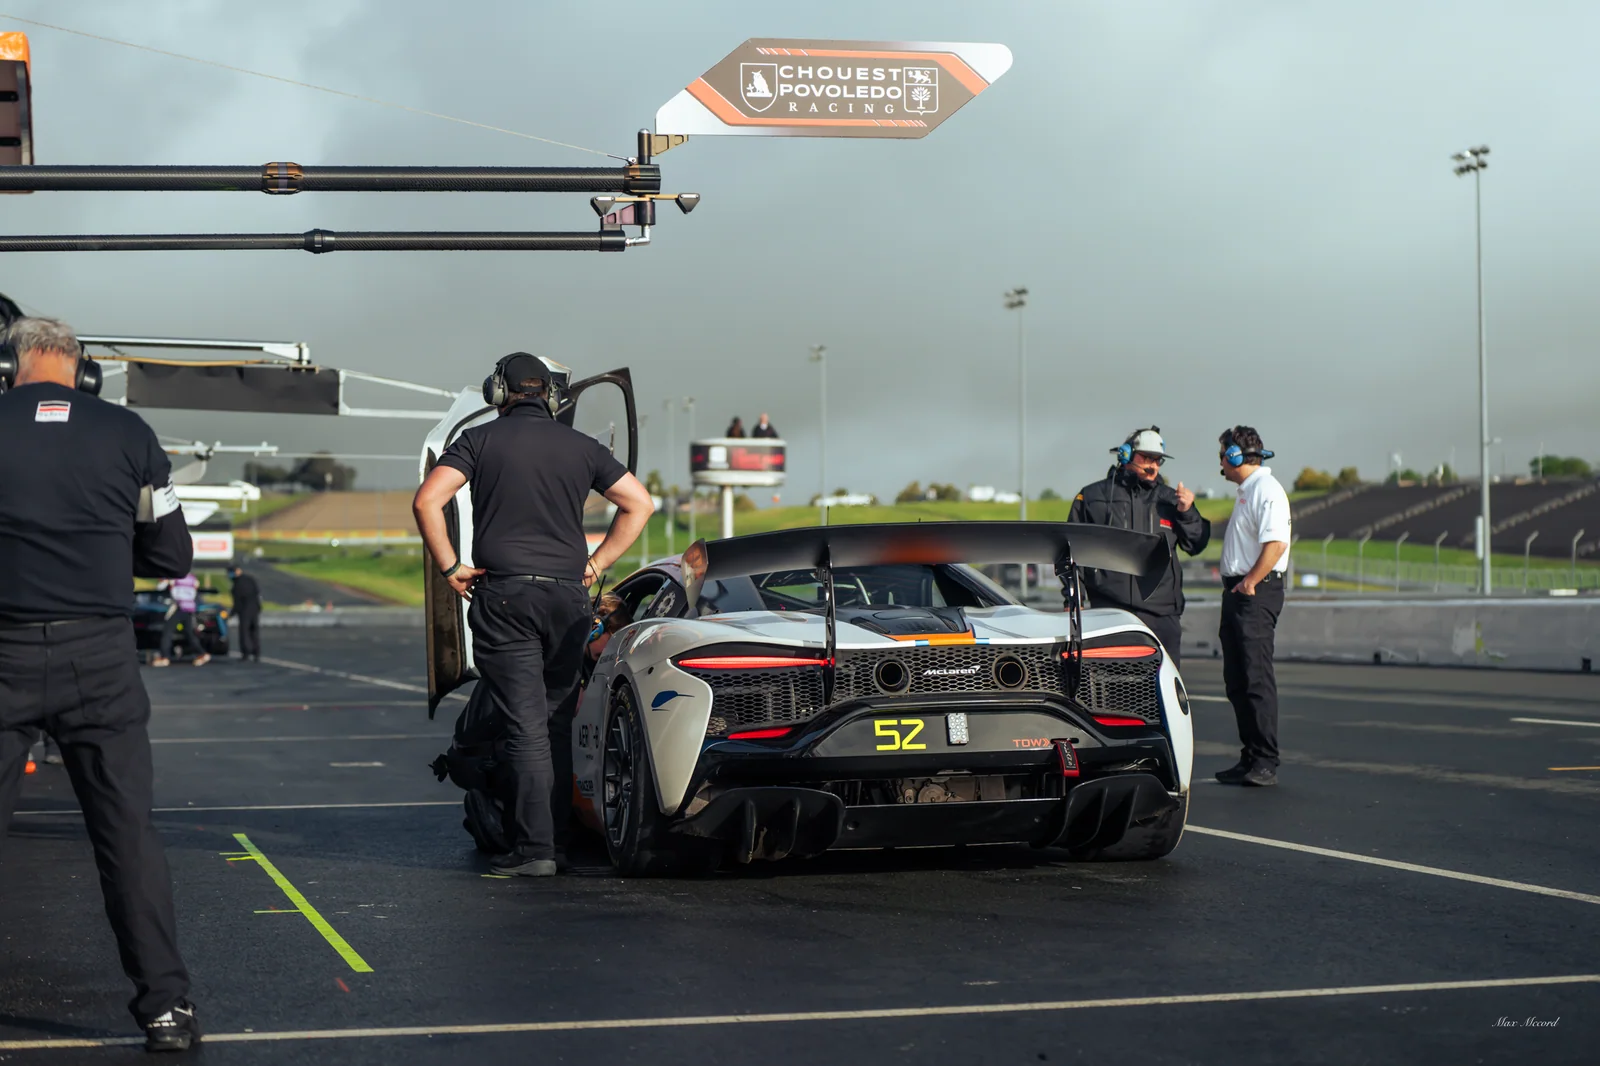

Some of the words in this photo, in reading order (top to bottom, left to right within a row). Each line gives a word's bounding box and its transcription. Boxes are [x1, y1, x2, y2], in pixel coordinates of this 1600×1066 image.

[779, 65, 901, 81] CHOUEST
[779, 83, 902, 99] POVOLEDO
[788, 102, 894, 113] RACING
[923, 665, 981, 676] McLaren
[874, 718, 927, 751] 52
[1012, 738, 1043, 748] TOW
